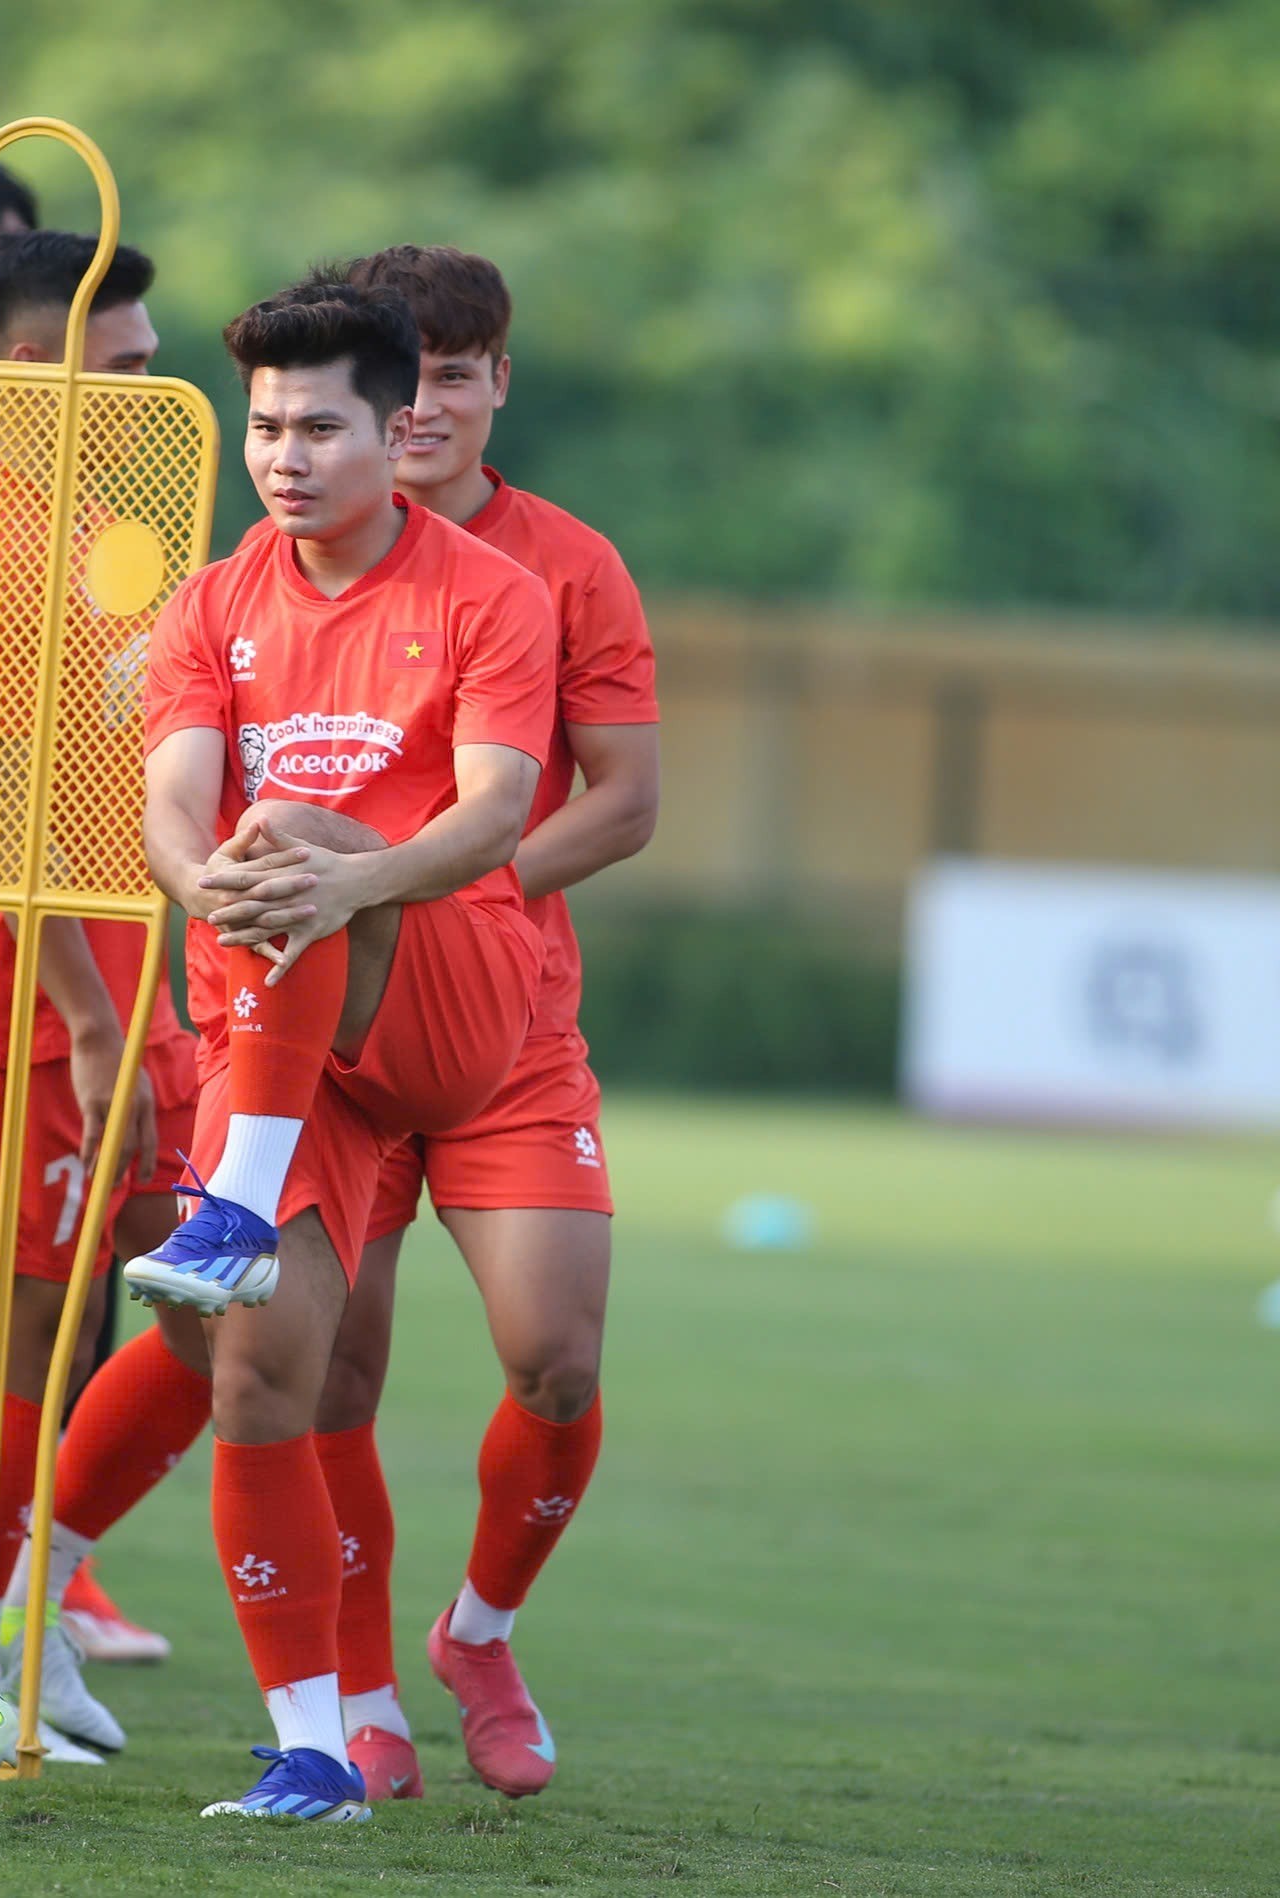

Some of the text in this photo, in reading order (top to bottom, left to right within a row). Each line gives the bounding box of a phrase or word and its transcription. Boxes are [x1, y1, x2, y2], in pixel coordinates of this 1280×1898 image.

[266, 716, 401, 743] Cook happiness
[44, 1153, 84, 1246] 7
